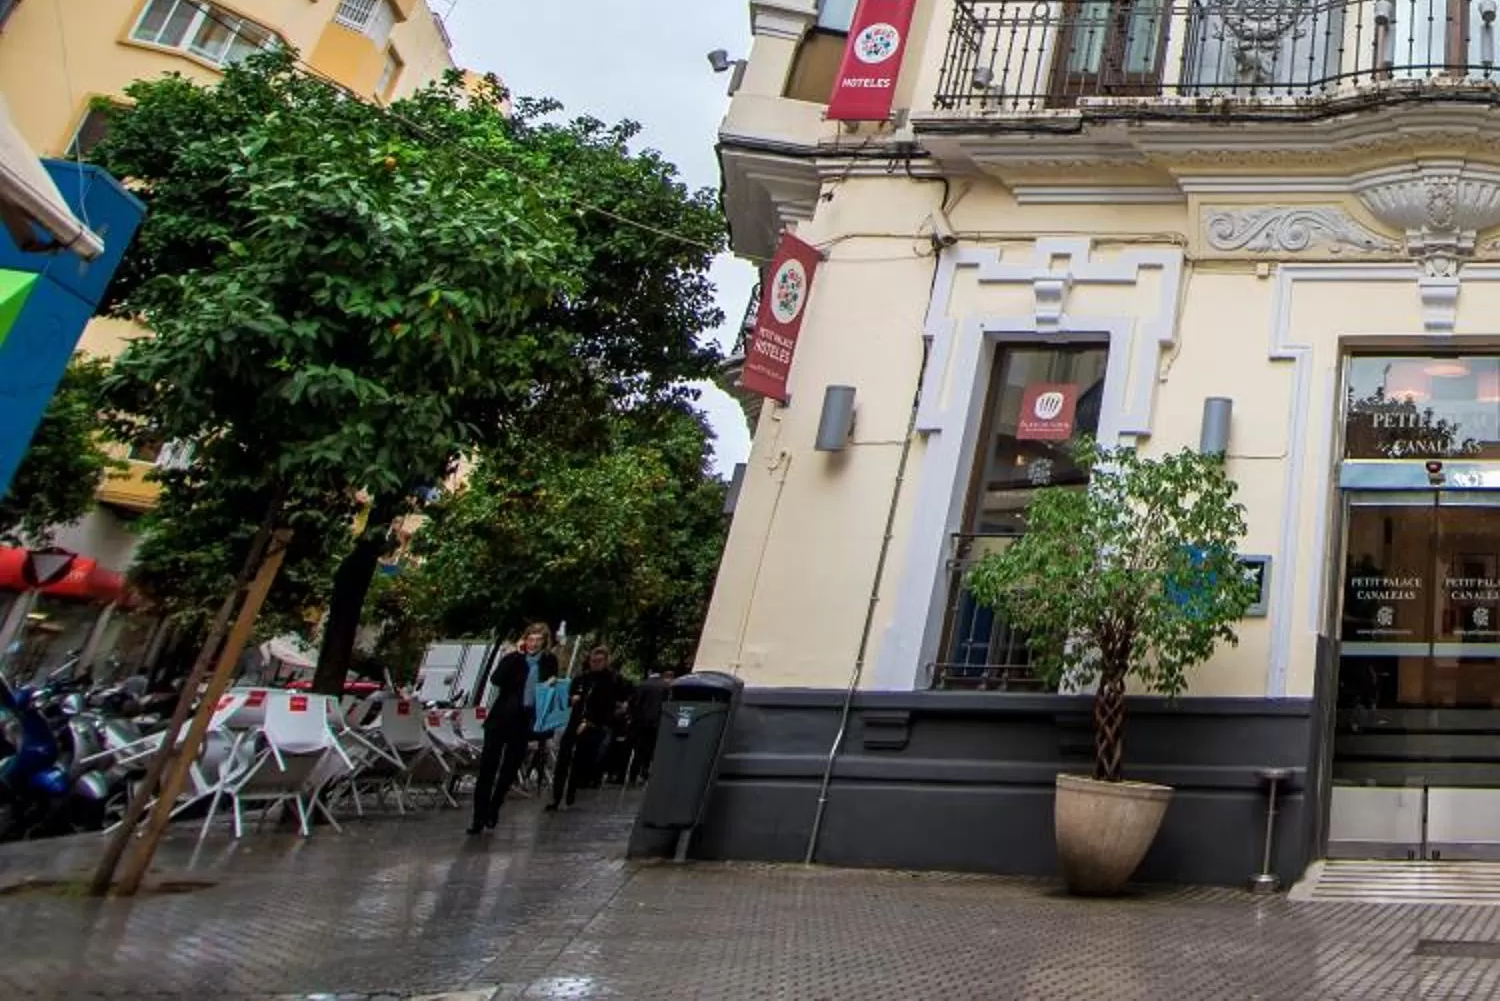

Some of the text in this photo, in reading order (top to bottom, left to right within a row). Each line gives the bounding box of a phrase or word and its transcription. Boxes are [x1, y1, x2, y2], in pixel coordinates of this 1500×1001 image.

[841, 78, 891, 88] HOTELES
[753, 339, 789, 364] HOTELES
[1394, 438, 1483, 455] CANALAS
[1351, 577, 1422, 588] PETIT PALACE
[1446, 577, 1477, 588] PETIT
[1357, 590, 1417, 600] CANALEJAS
